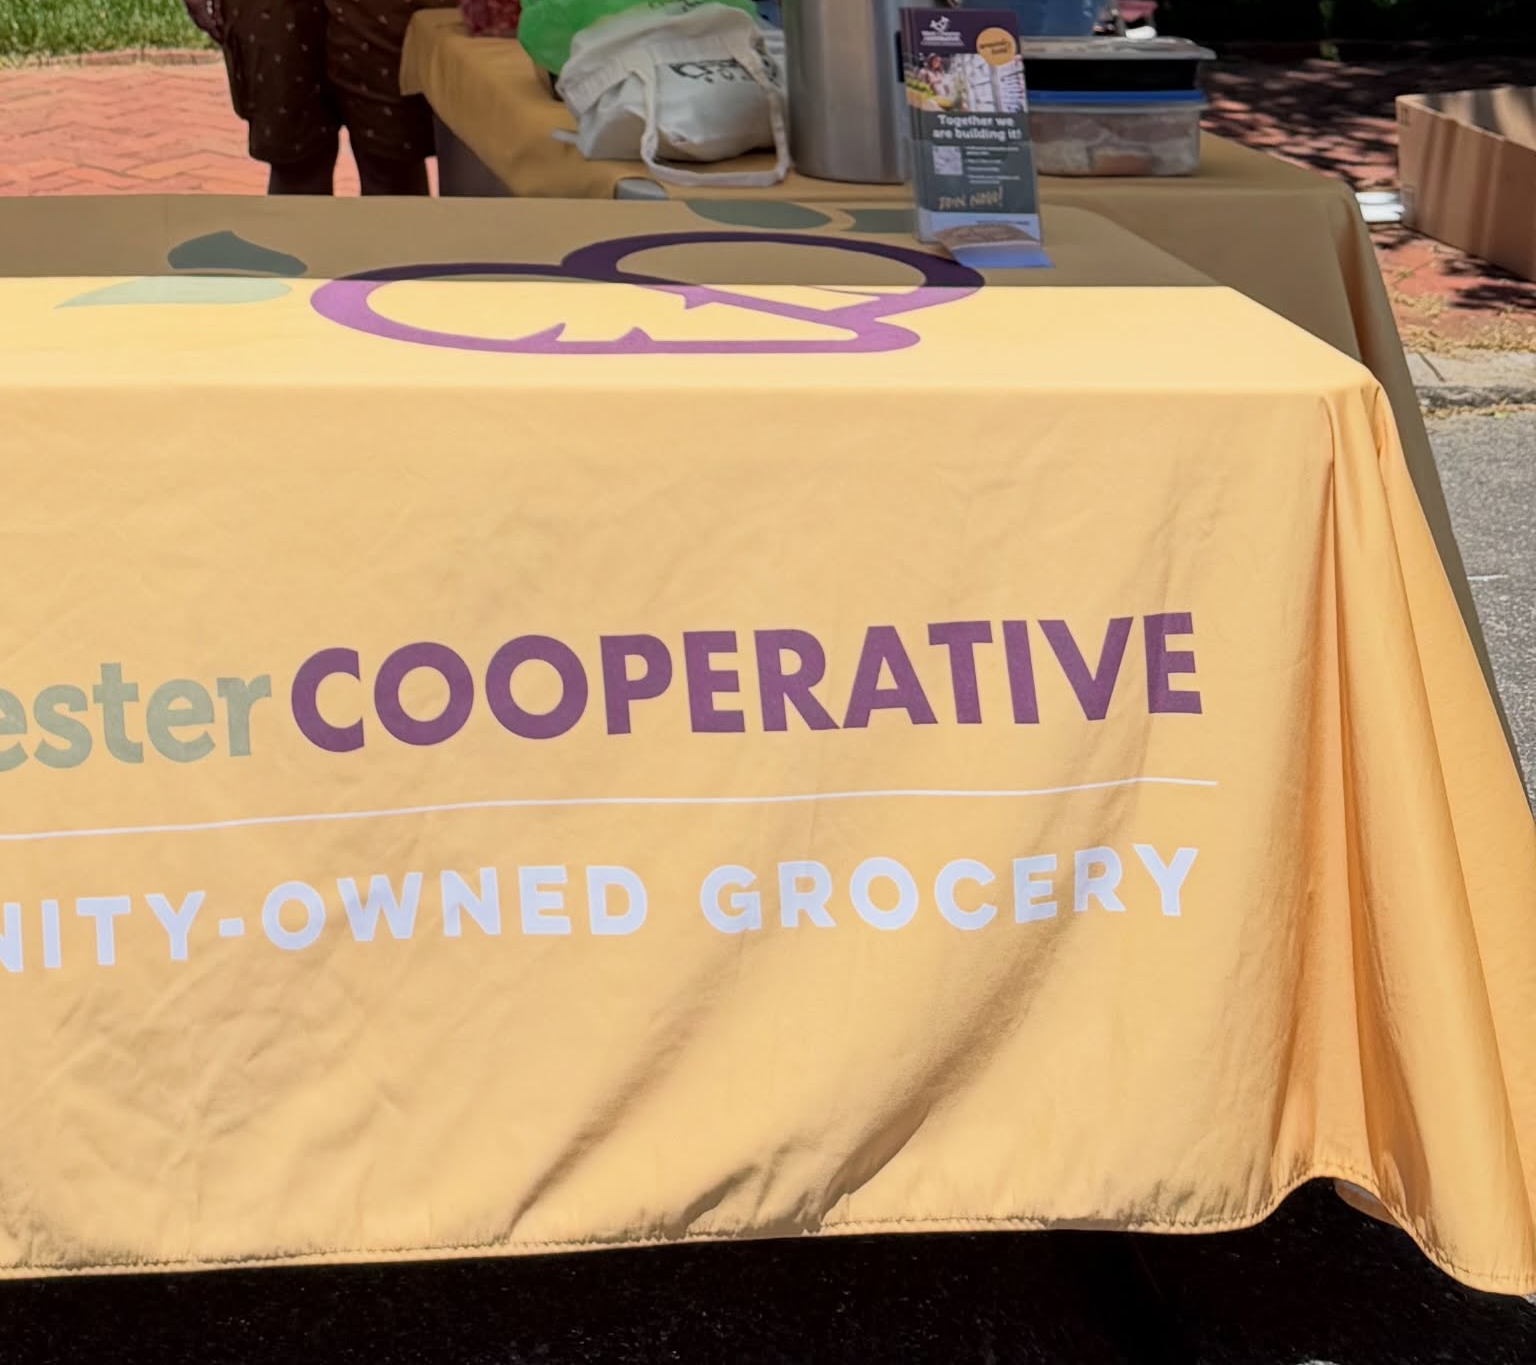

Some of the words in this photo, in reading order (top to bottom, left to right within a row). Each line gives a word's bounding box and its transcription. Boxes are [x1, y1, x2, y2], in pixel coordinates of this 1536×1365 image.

[932, 129, 953, 138] are
[954, 128, 1007, 142] building
[937, 114, 992, 127] Together
[995, 117, 1015, 127] we
[291, 611, 1204, 753] COOPERATIVE
[699, 842, 1199, 933] GROCERY
